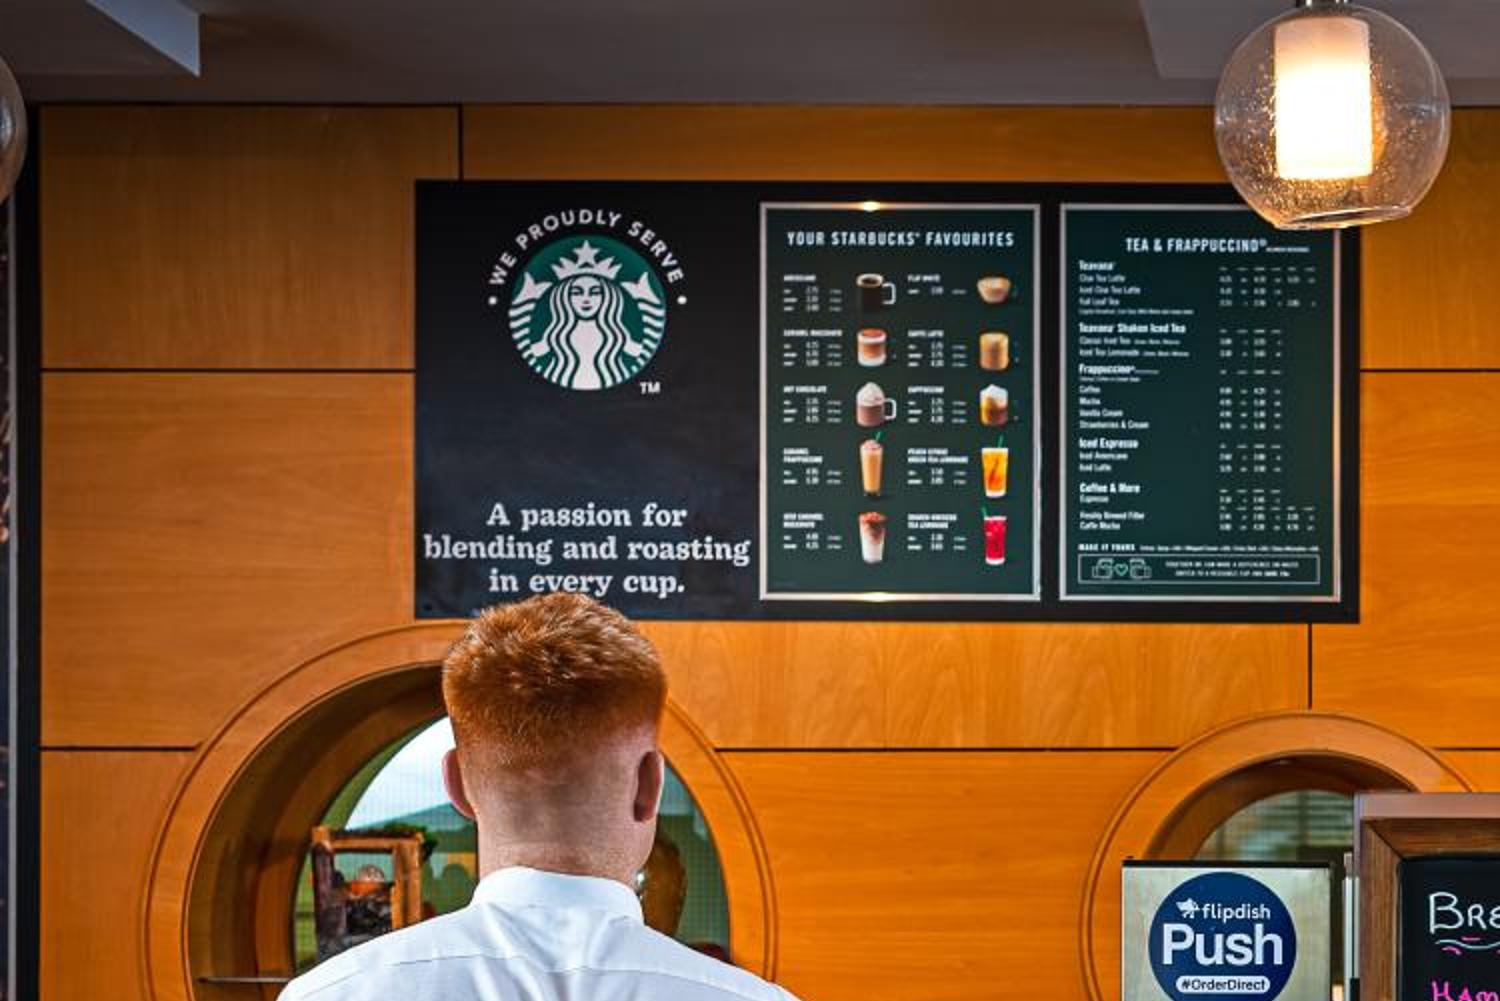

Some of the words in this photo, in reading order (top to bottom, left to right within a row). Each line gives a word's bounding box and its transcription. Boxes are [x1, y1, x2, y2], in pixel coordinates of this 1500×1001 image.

[489, 253, 517, 286] WE
[516, 209, 622, 251] PROUDLY
[627, 220, 685, 283] SERVE
[787, 231, 825, 247] YOUR
[925, 231, 1015, 247] FAVOURITES
[1125, 237, 1149, 253] TEA
[1153, 237, 1163, 253] &
[640, 382, 660, 394] TM
[486, 503, 510, 527] A
[521, 503, 632, 532] passion
[642, 503, 688, 527] for
[423, 534, 552, 566] blending
[563, 536, 618, 560] and
[627, 536, 751, 567] roasting
[489, 568, 518, 592] in
[529, 574, 612, 598] every
[623, 574, 685, 598] cup.
[1202, 904, 1271, 923] flipdish
[1162, 923, 1283, 966] Push
[1181, 979, 1267, 992] #OrderDirect
